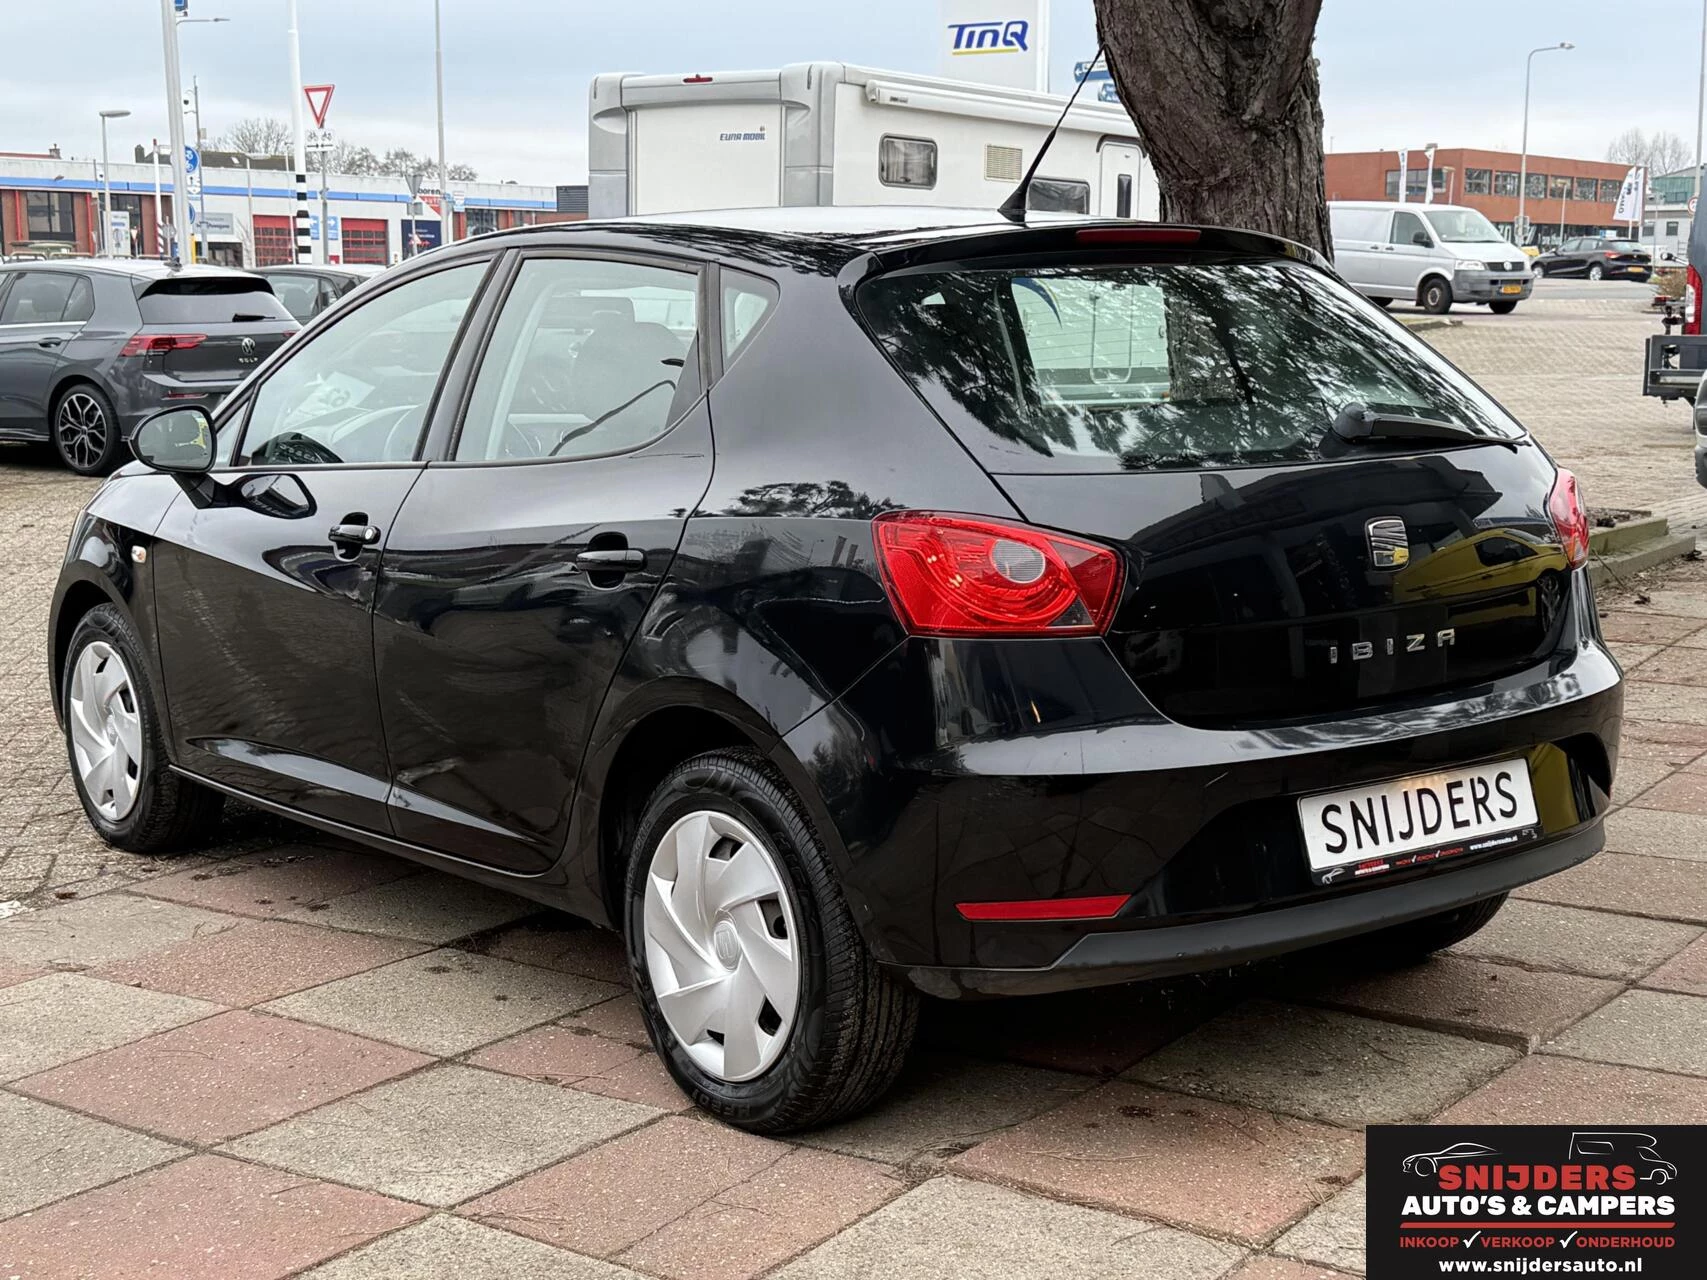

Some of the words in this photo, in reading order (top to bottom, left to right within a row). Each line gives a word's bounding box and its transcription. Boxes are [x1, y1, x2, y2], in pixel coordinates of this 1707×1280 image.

[948, 20, 1028, 51] TinQ
[1329, 628, 1456, 664] IBIZA
[1321, 771, 1518, 854] SNIJDERS
